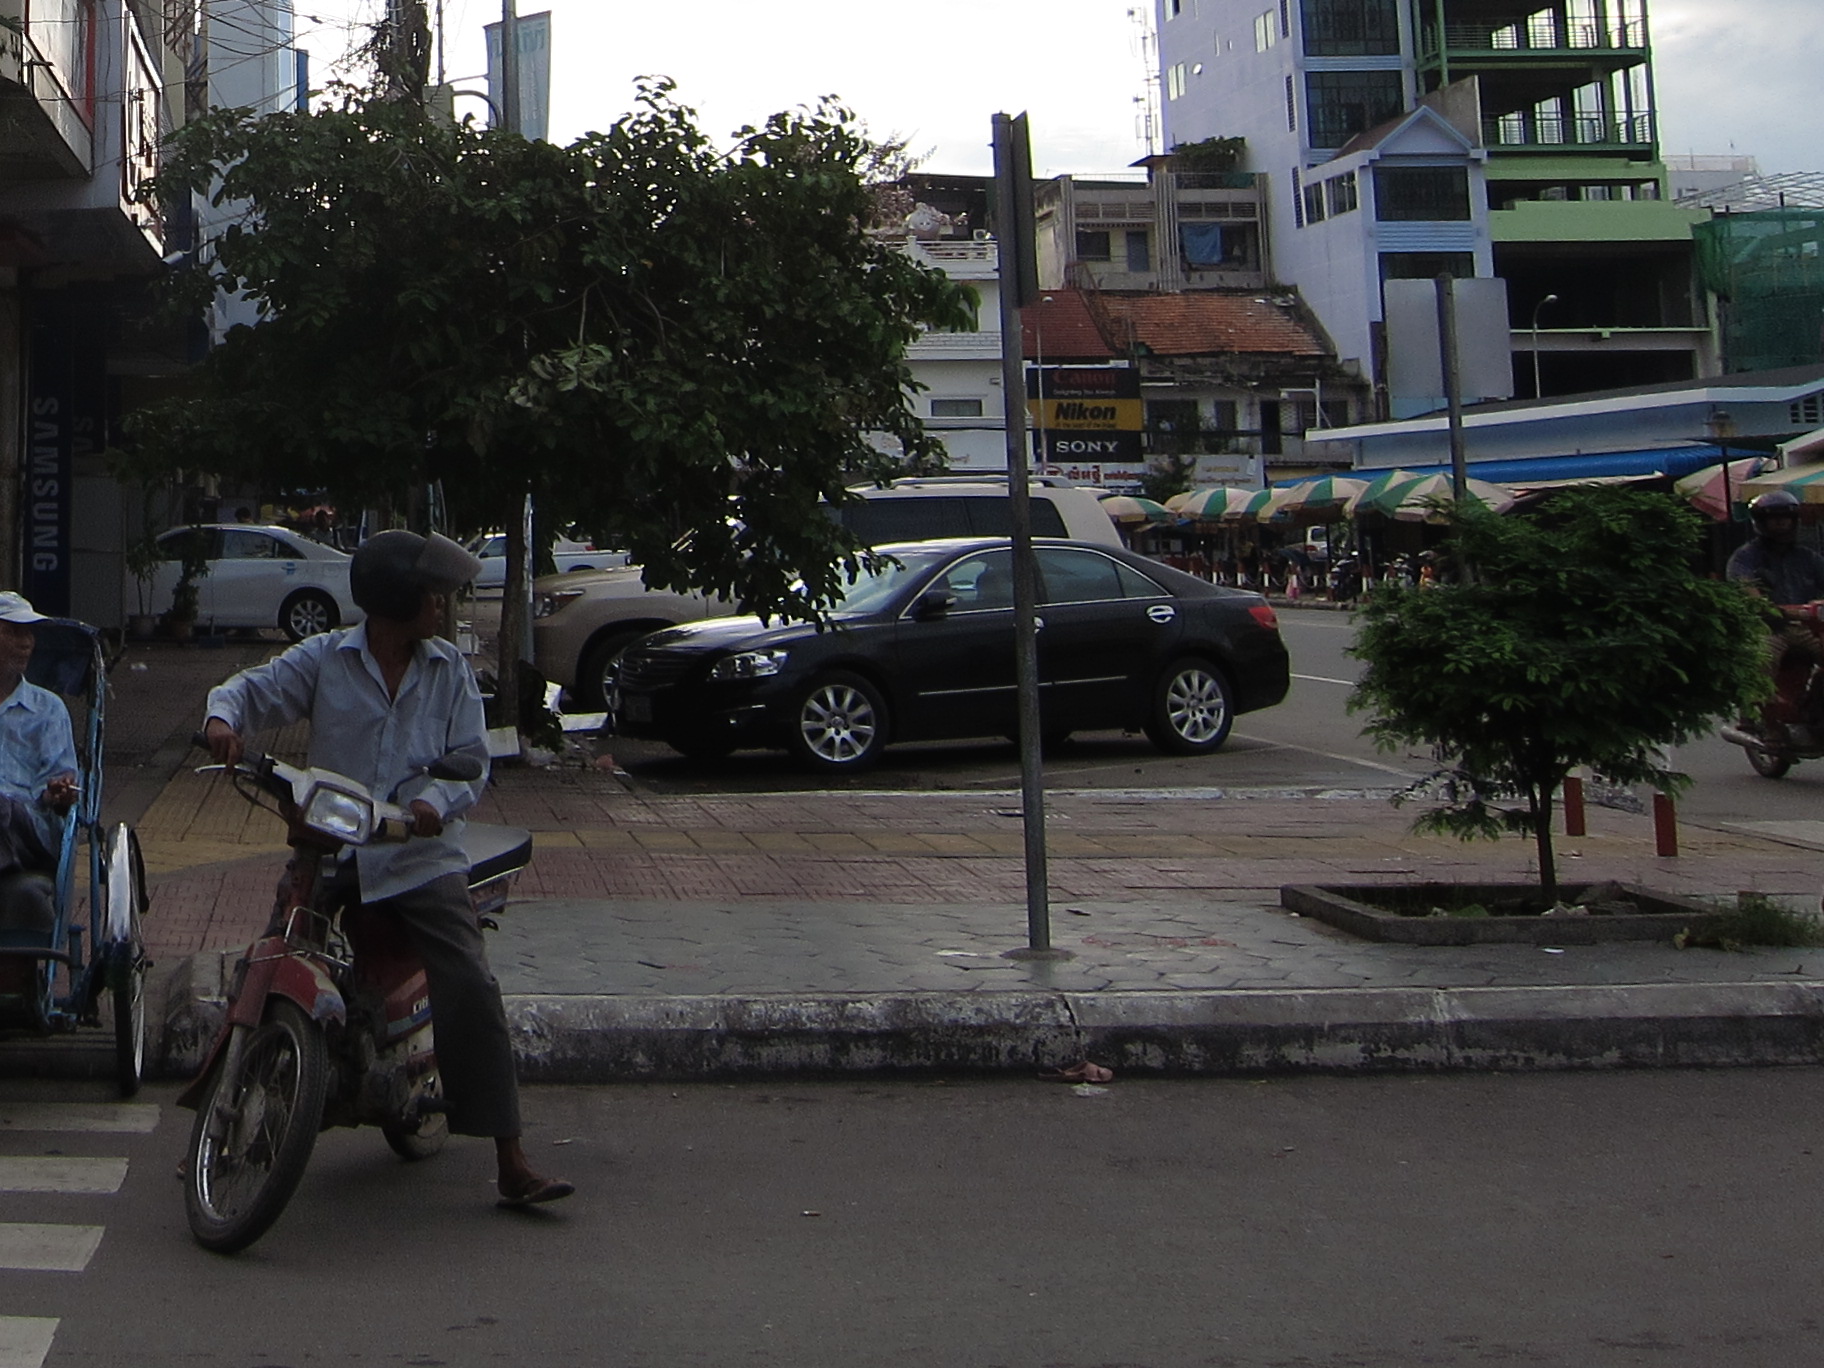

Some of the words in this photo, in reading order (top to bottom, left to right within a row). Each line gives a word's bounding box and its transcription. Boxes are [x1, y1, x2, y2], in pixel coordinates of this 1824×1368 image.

[1055, 402, 1117, 421] Nikon
[1055, 440, 1118, 453] SONY
[31, 396, 60, 572] SAMSUNG
